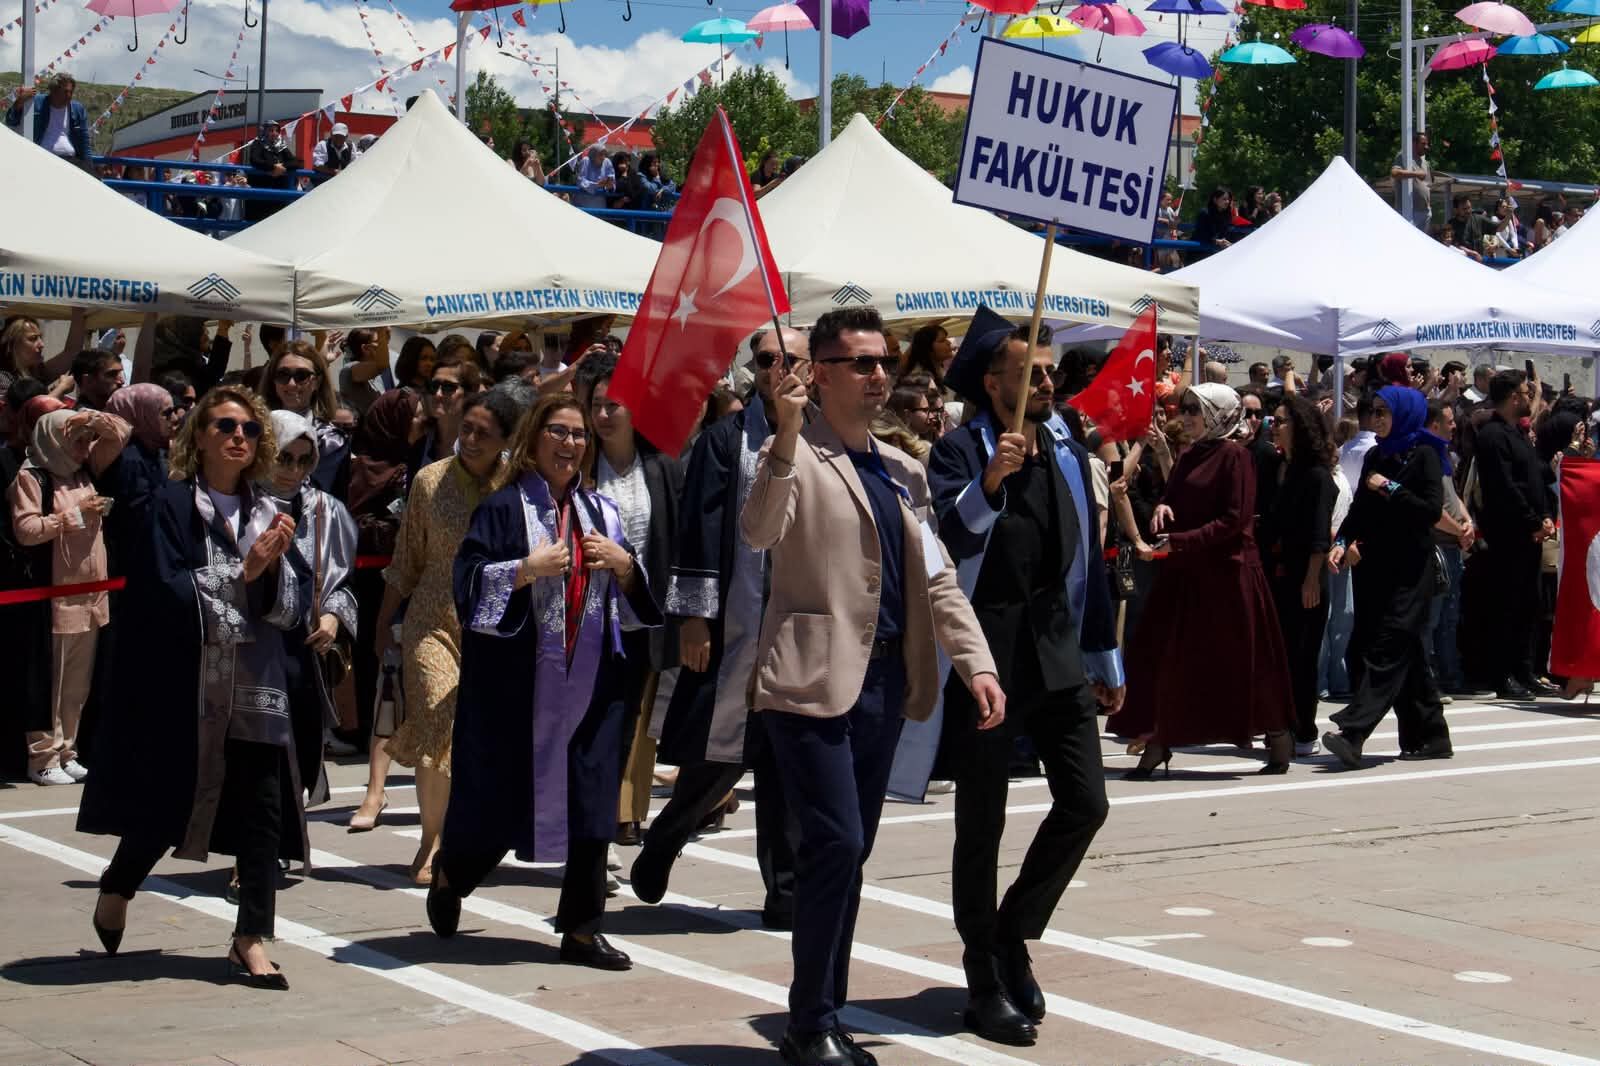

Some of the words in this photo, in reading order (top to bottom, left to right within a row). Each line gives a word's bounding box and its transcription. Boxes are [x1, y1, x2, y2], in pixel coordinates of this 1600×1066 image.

[201, 102, 246, 122] FÜLTESİ
[1007, 71, 1143, 145] HUKUK
[969, 135, 1154, 219] FAKÜLTESİ
[32, 274, 158, 303] ÜNİVERSİTESİ
[425, 292, 489, 316] ÇANKIRI
[492, 289, 581, 311] KARATEKİN
[583, 289, 643, 310] ÜNİVER
[895, 291, 949, 312] ÇANKIRI
[951, 290, 1023, 310] KARATEKİN
[1026, 292, 1109, 317] ÜİVERSİTESİ
[1416, 323, 1454, 342] ÇANKIRI
[1457, 321, 1511, 339] KARATEKİN
[1512, 322, 1576, 341] ÜNİVERSİTESİ
